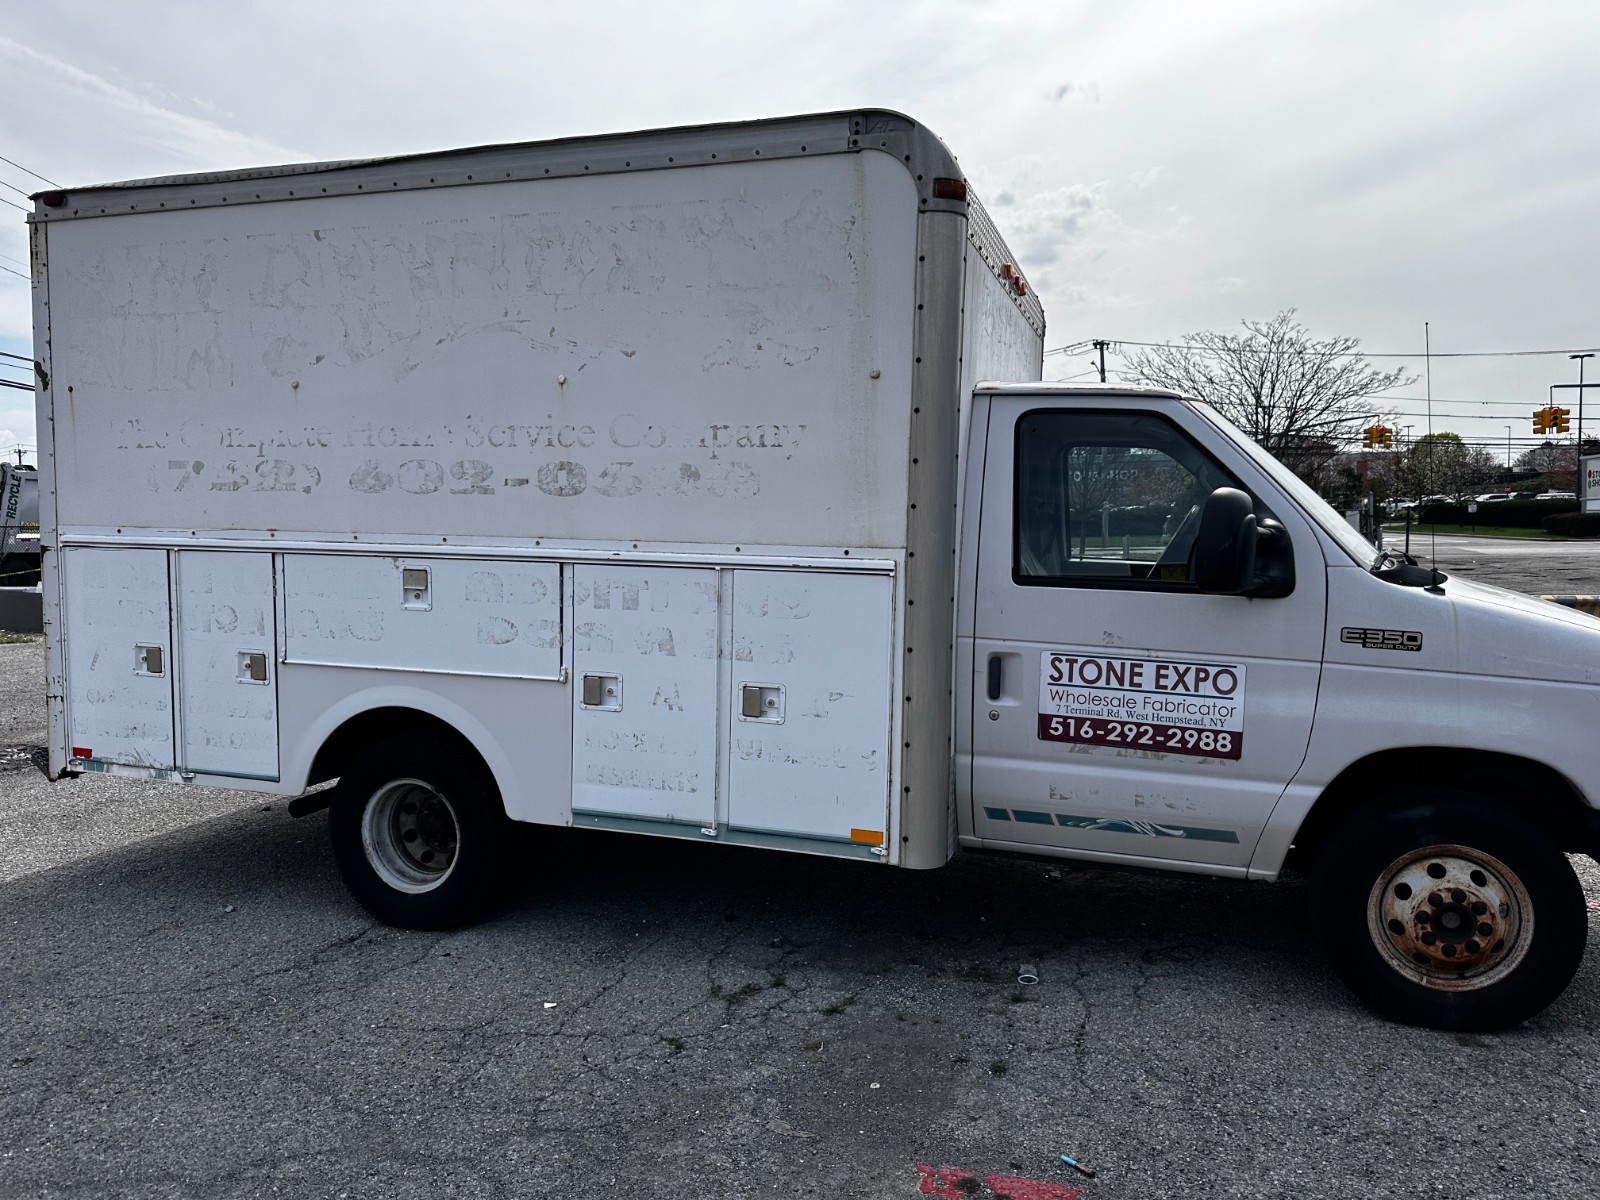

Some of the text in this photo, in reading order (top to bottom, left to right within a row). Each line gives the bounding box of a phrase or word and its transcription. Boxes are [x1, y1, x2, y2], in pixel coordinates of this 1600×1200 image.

[6, 473, 22, 519] RECYCLE
[1049, 656, 1238, 696] STONE EXPO
[1049, 688, 1237, 718] Wholesale Fabricator
[1056, 704, 1061, 713] 7
[1064, 704, 1104, 717] Terminal
[1126, 711, 1149, 721] West
[1151, 714, 1207, 728] Hempstead,
[1209, 718, 1227, 728] NY
[1049, 717, 1232, 753] 516-292-2988
